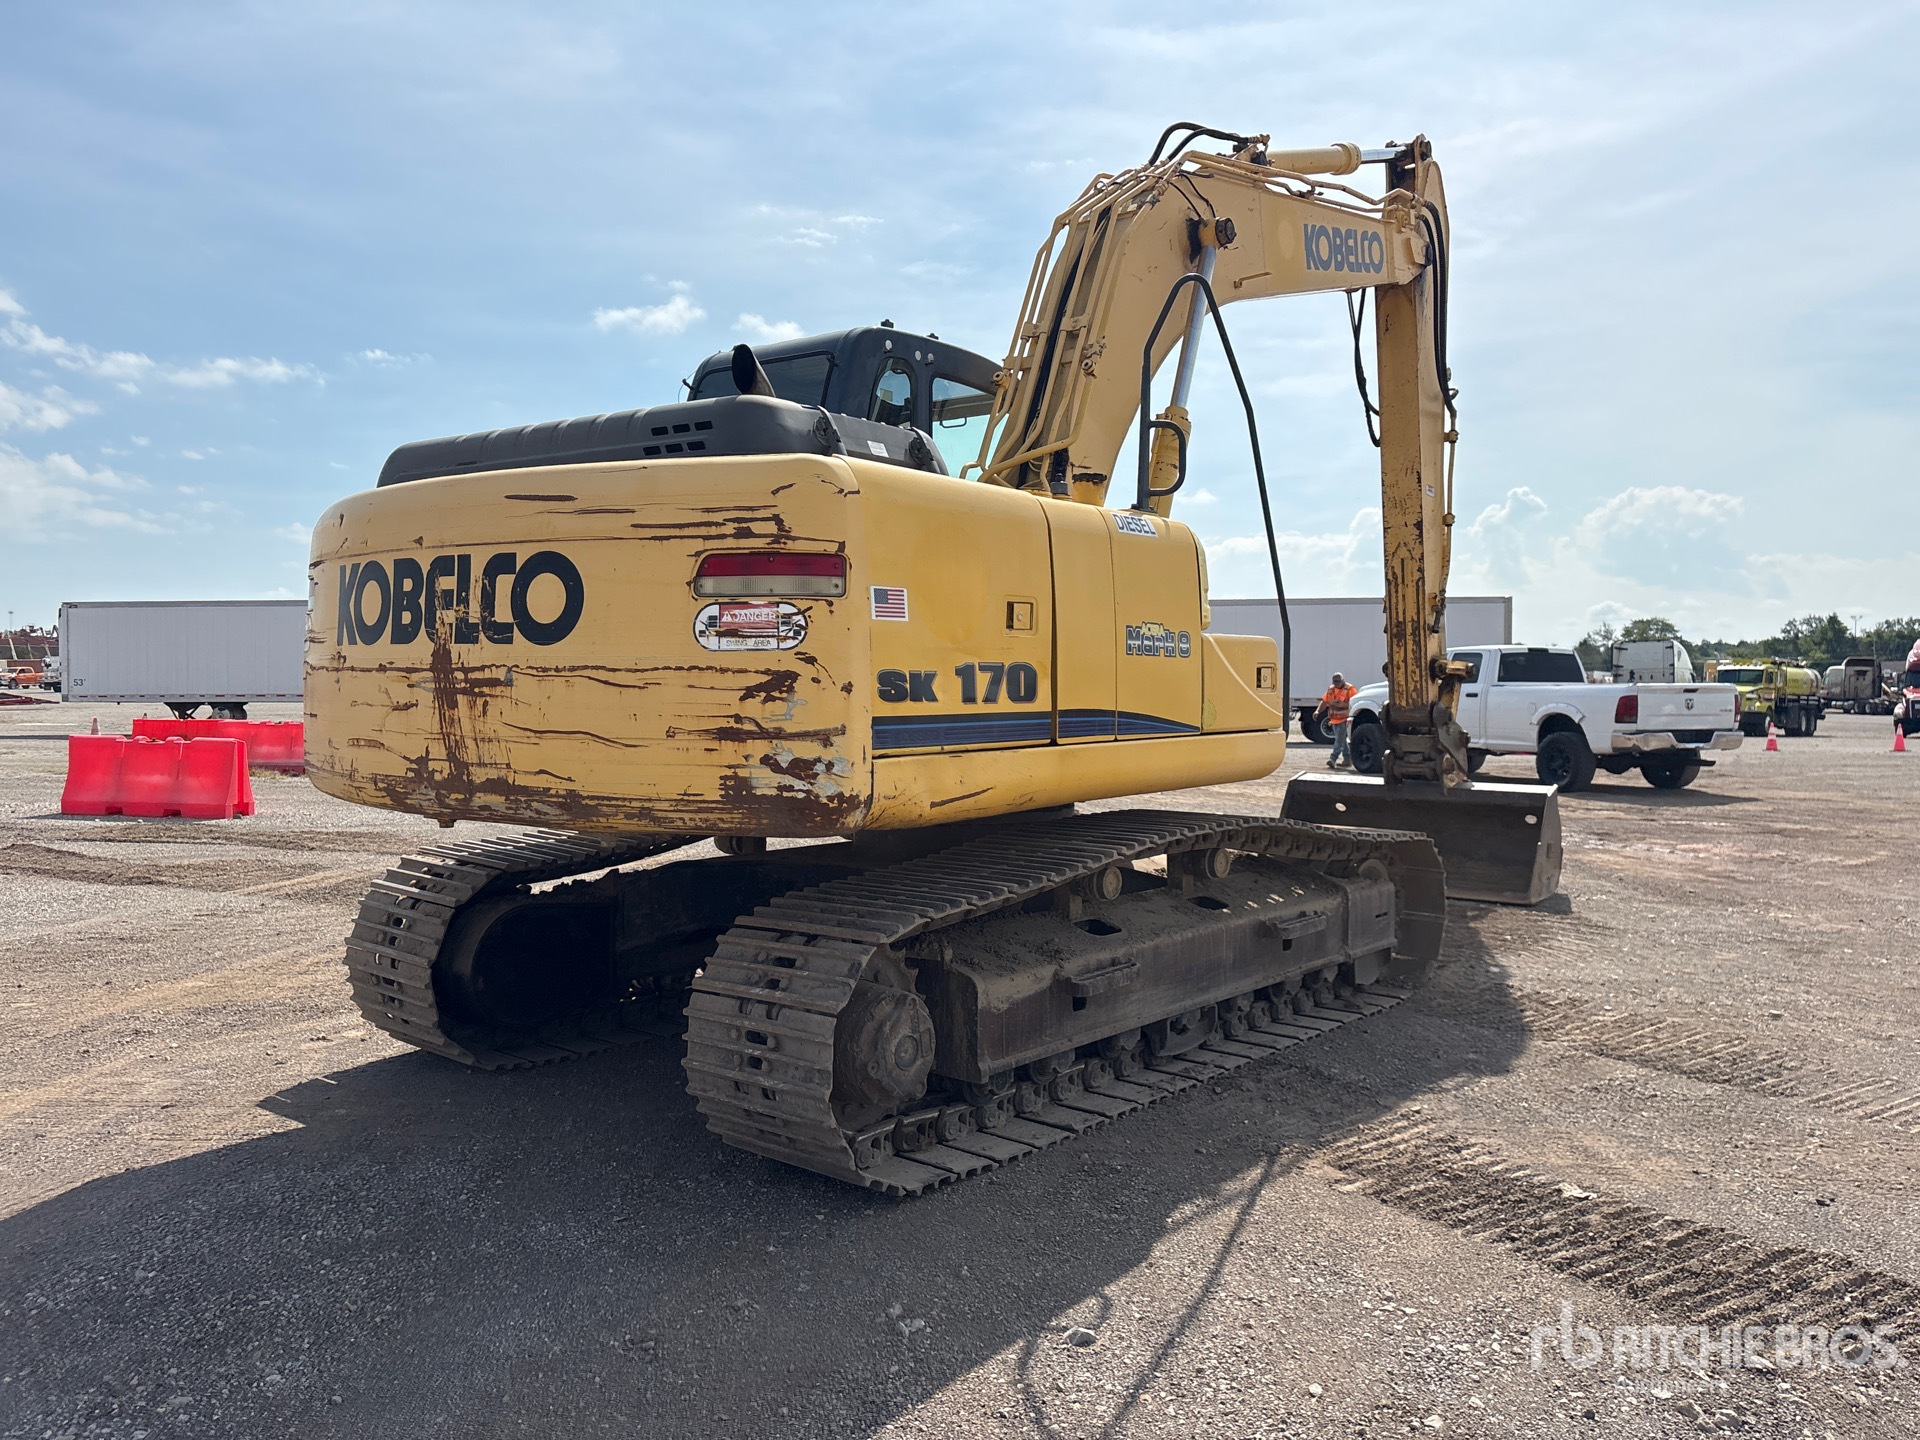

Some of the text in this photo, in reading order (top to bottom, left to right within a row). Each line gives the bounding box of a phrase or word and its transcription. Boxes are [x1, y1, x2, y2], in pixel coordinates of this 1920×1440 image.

[1303, 223, 1384, 275] KOBELCO
[1112, 513, 1156, 535] DIESEL
[337, 551, 584, 646] KOBELCO
[732, 610, 777, 622] DANGER
[726, 638, 772, 647] SWING AREA
[1177, 630, 1191, 658] 8
[876, 661, 1038, 704] SK 170
